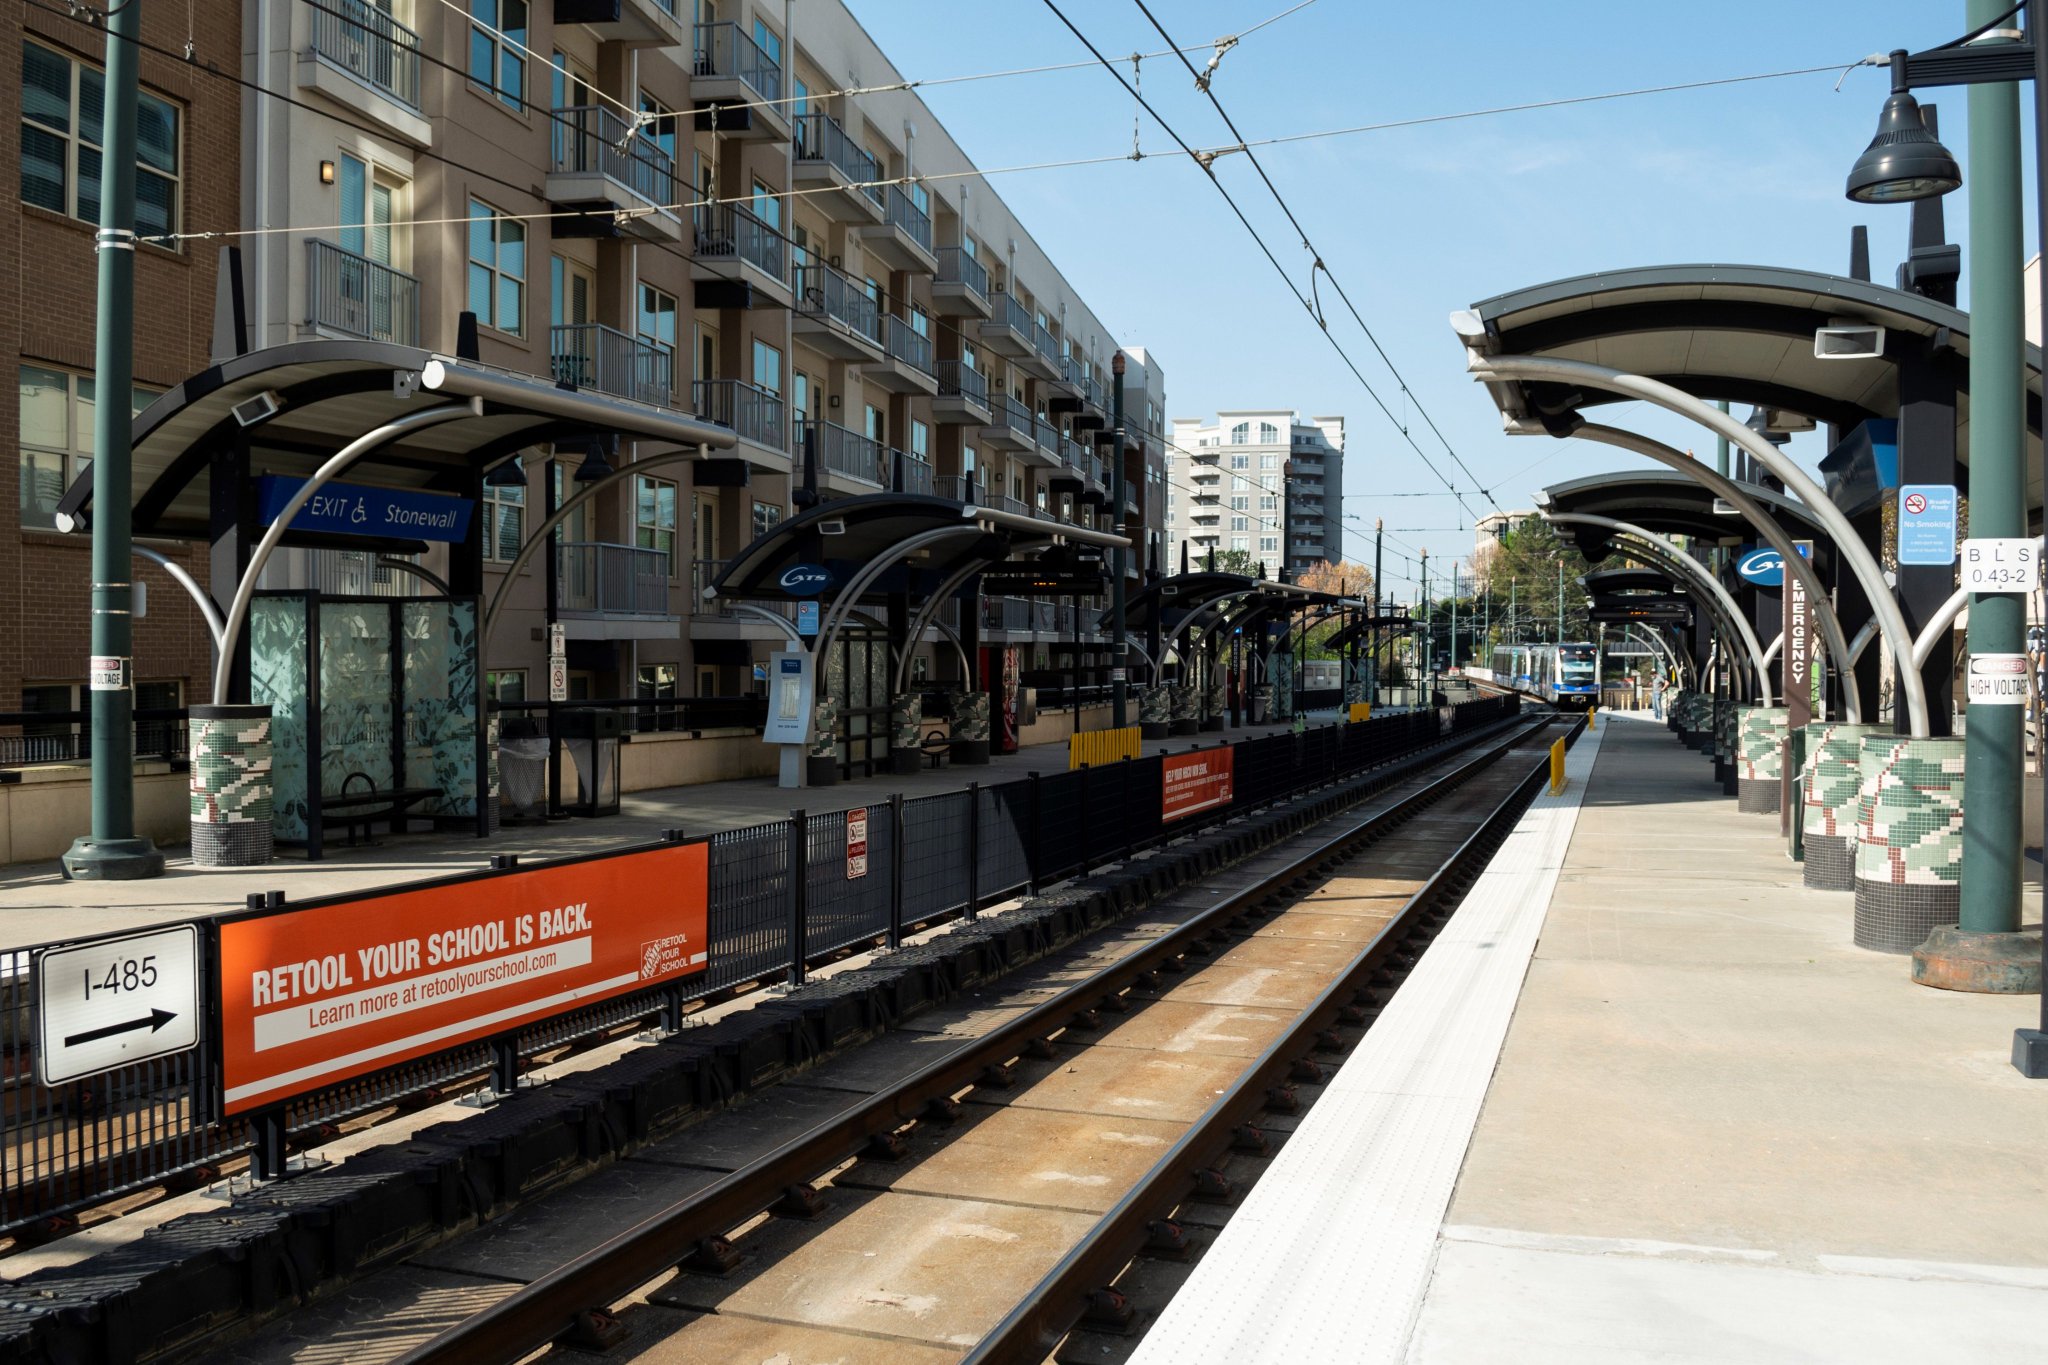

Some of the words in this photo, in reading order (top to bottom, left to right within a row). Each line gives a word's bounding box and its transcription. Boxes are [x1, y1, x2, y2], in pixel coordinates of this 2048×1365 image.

[311, 496, 348, 517] EXIT
[385, 504, 457, 528] Stonewall
[1903, 520, 1915, 528] No
[1916, 520, 1952, 529] Smoking
[780, 567, 827, 587] CATS
[1972, 569, 2026, 583] 0.43-2
[1792, 579, 1805, 684] EMERGENCY
[1971, 679, 1991, 695] HIGH
[1994, 679, 2027, 695] VOLTAGE
[661, 933, 688, 948] RETOOL
[252, 953, 352, 1008] RETOOL
[358, 938, 421, 981] YOUR
[427, 920, 509, 966] SCHOOL
[515, 914, 534, 946] IS
[539, 902, 592, 940] BACK.
[661, 947, 680, 961] YOUR
[661, 957, 689, 973] SCHOOL
[84, 955, 158, 1001] I-485
[309, 1001, 355, 1028] Learn
[359, 990, 399, 1016] more
[402, 983, 418, 1005] at
[420, 952, 557, 1000] retoolyourschool.com
